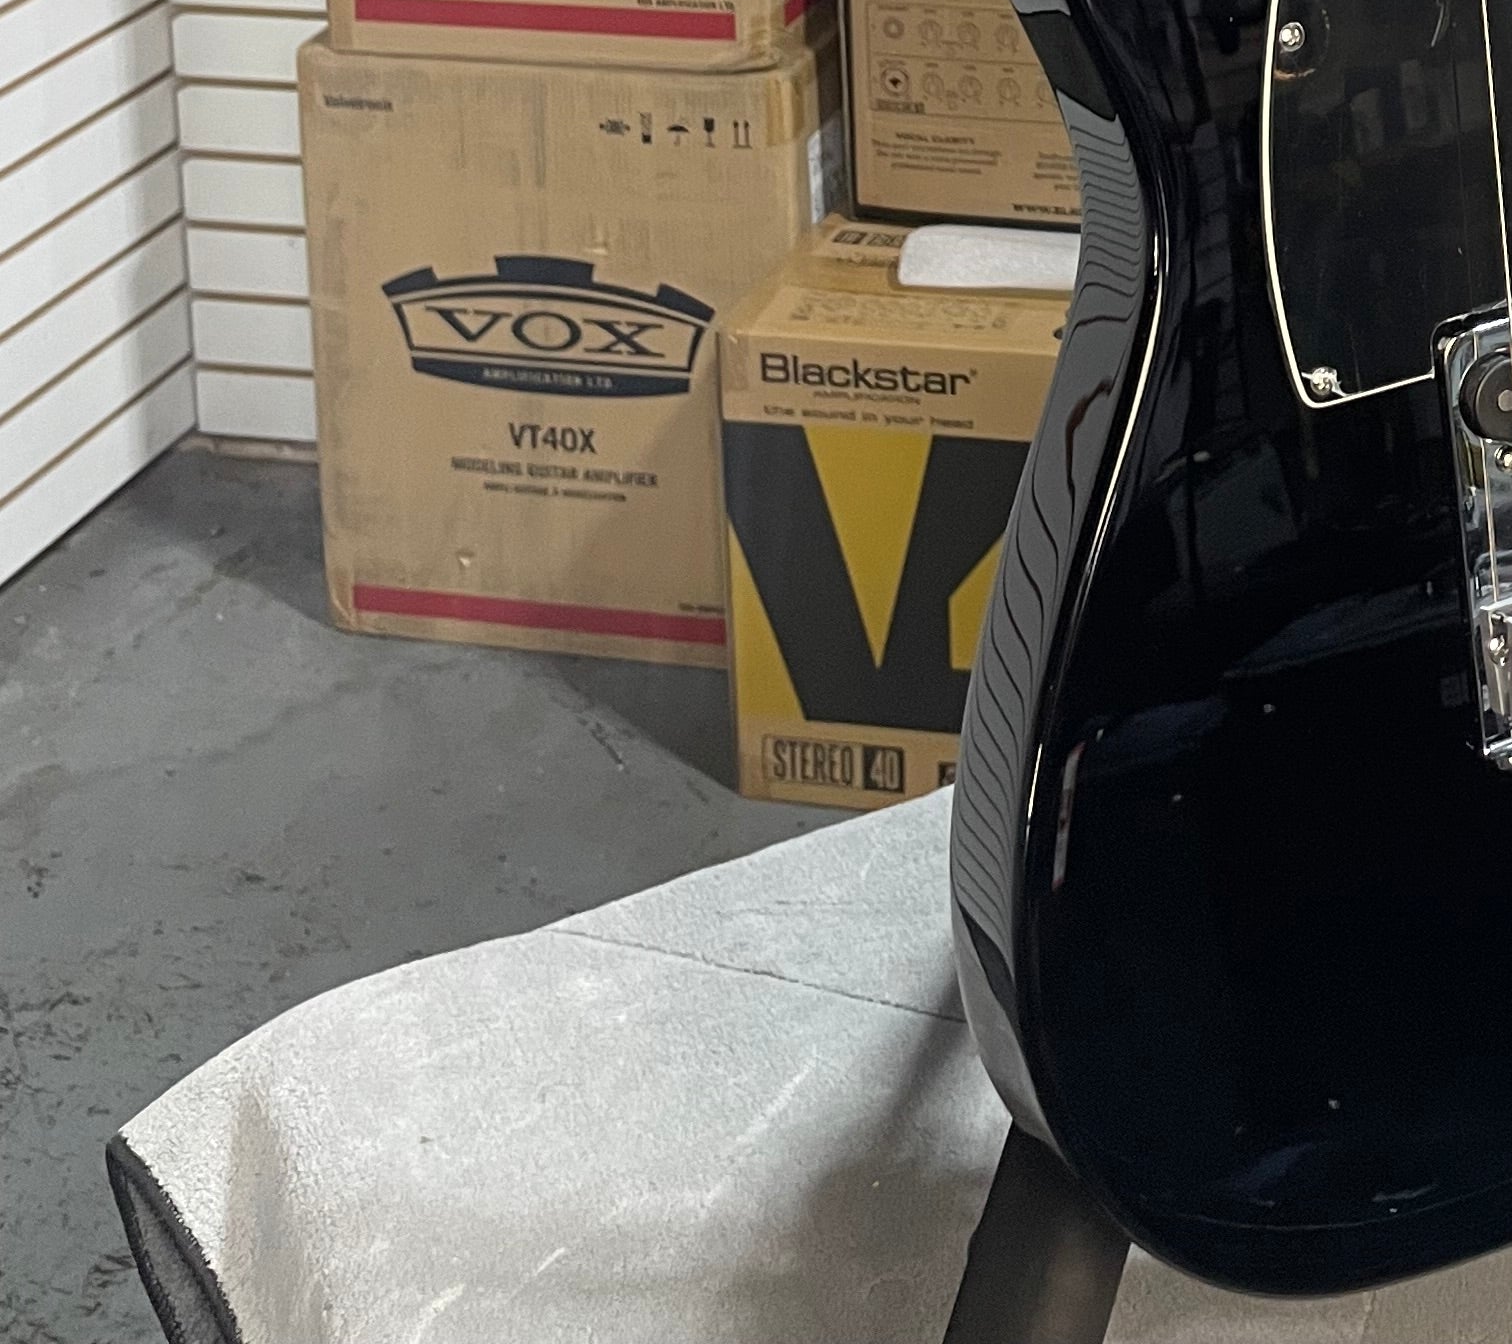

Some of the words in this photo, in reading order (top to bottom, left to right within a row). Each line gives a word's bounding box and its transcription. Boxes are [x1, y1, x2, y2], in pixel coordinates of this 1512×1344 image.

[425, 305, 665, 358] VOX
[760, 352, 972, 396] Blackstar
[509, 422, 597, 454] VT40X
[772, 739, 855, 787] STEREO
